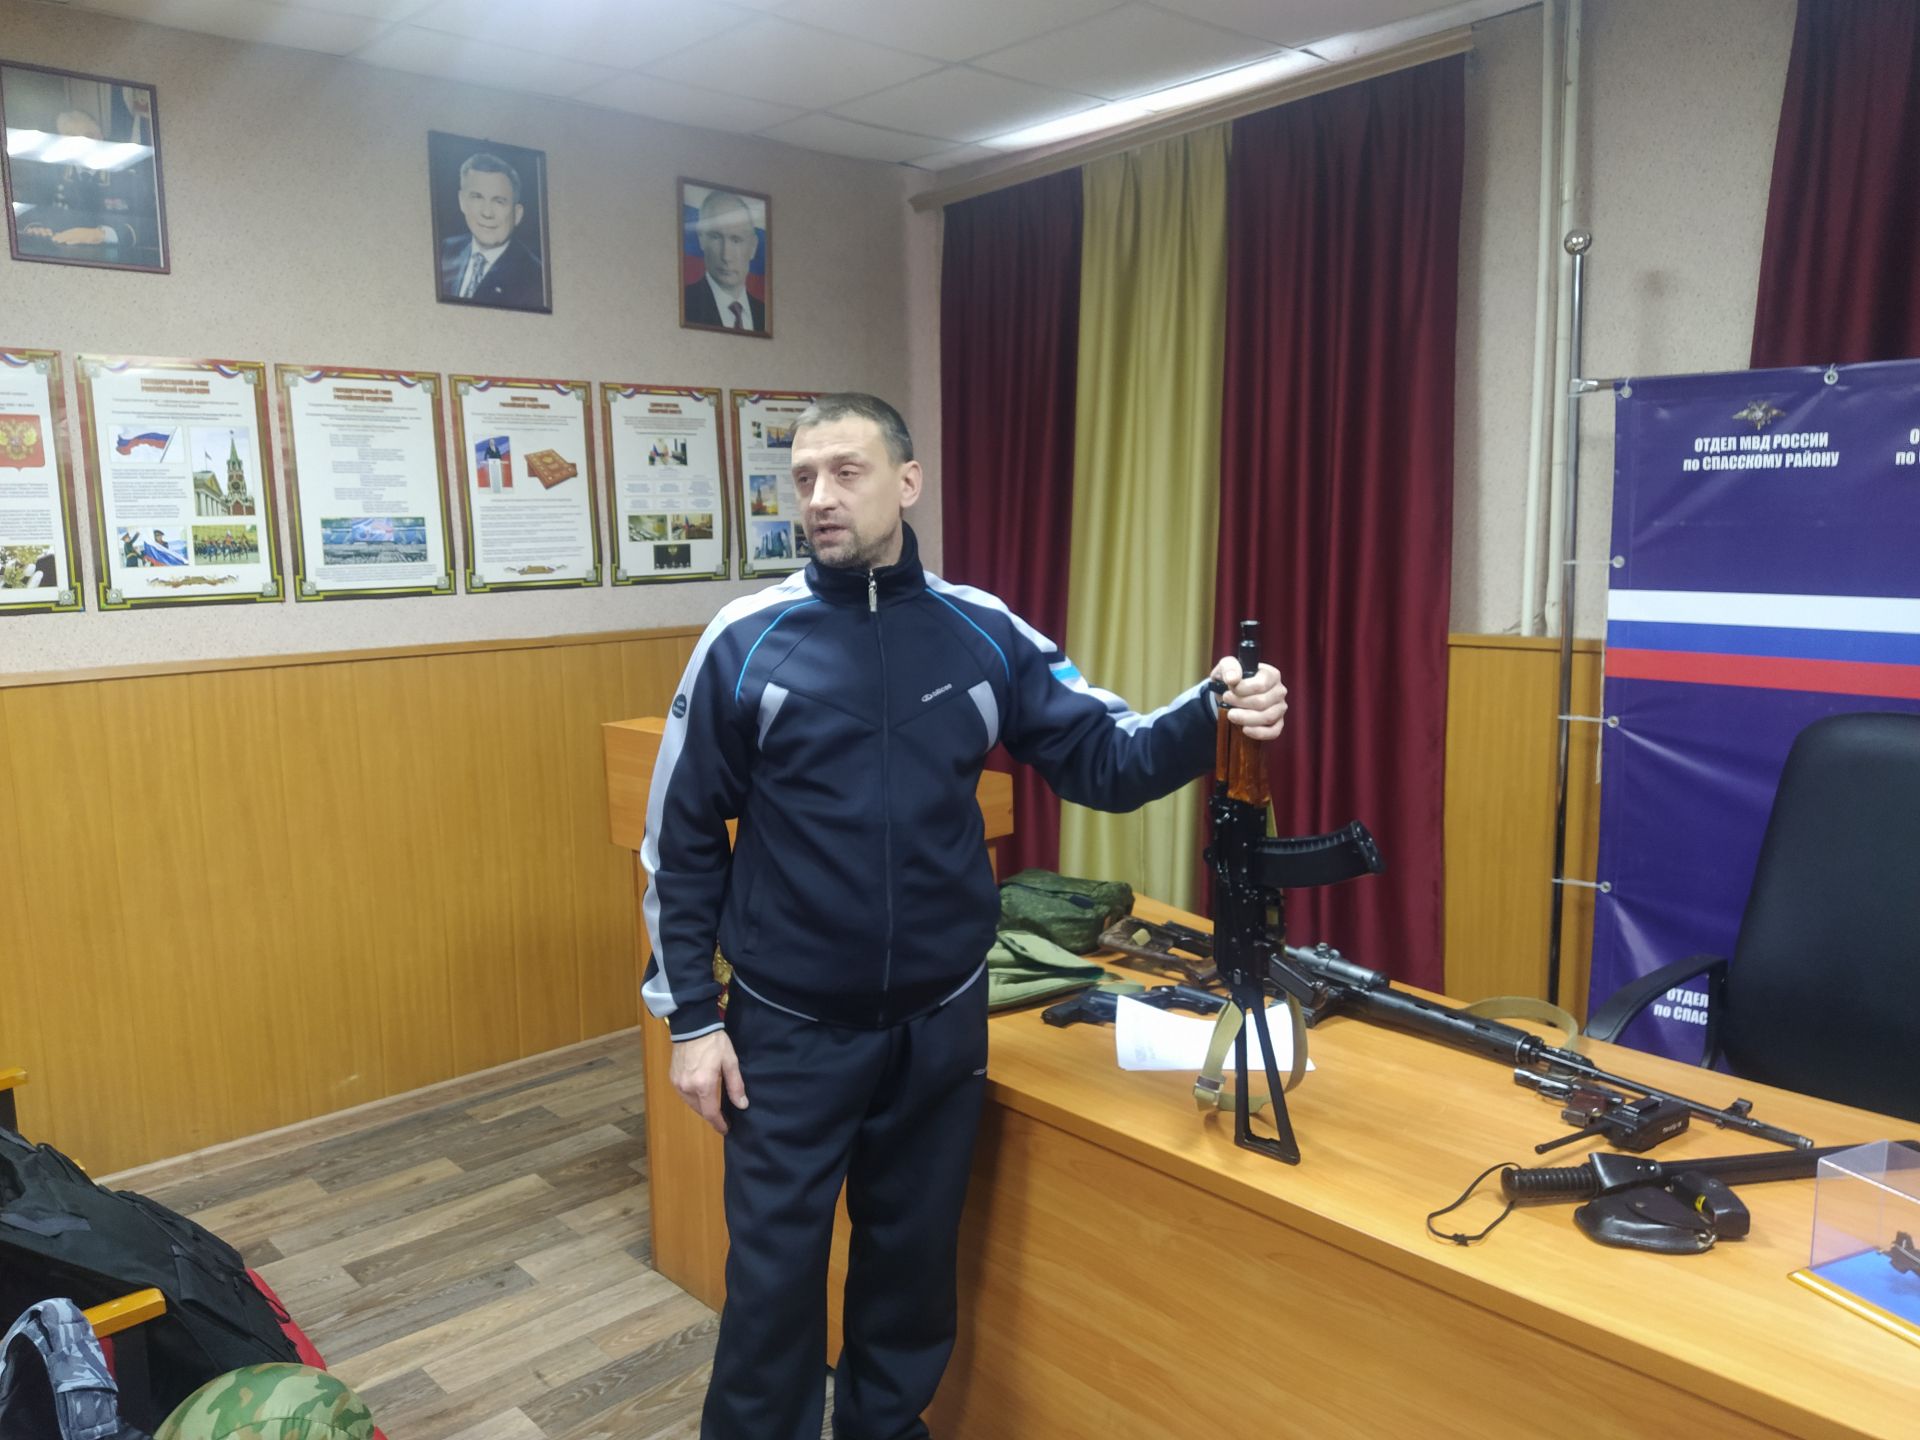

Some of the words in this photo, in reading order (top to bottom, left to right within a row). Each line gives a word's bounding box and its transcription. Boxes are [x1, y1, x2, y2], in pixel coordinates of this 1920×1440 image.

[1694, 436, 1737, 453] ОТДЕЛ
[1739, 435, 1770, 451] МВД
[1772, 432, 1829, 449] РОССИИ
[1702, 453, 1783, 471] СПАССКОМУ
[1785, 450, 1840, 468] РАЙОНУ
[1666, 988, 1710, 1008] ОТДЕЛ
